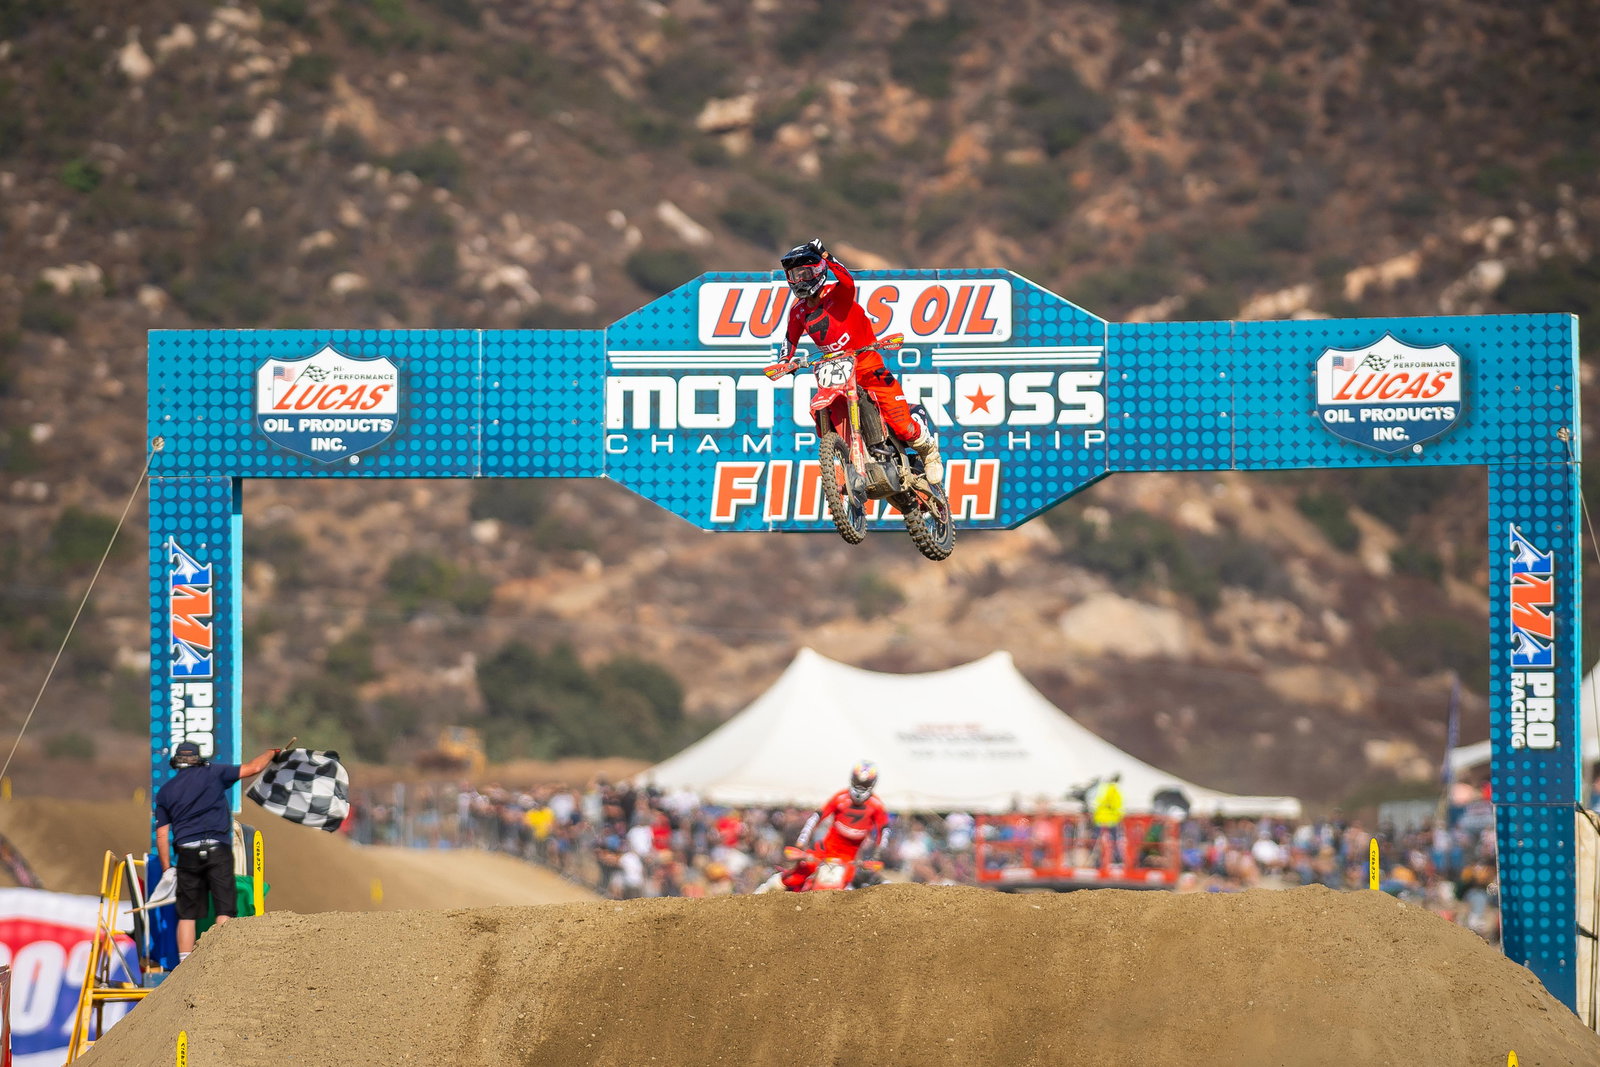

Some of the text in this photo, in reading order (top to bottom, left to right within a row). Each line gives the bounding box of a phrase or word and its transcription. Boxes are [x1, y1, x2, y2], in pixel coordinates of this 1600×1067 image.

[711, 284, 998, 338] LUS OIL
[817, 332, 850, 353] EICO
[818, 359, 853, 388] 83
[1393, 361, 1456, 369] PERFORMANCE
[272, 384, 393, 410] LUCAS
[1332, 371, 1453, 401] LUCAS
[606, 370, 1105, 430] MOTROSS
[263, 418, 394, 433] OIL PRODUCTS
[1324, 406, 1456, 424] OIL PRODUCTS
[310, 437, 347, 451] INC.
[605, 429, 1106, 454] CHAMPSHIP
[1373, 427, 1410, 441] INC.
[709, 458, 1001, 523] FINH
[169, 535, 213, 678] AMA
[1509, 522, 1555, 749] AMA PRO
[1510, 672, 1525, 749] RACING
